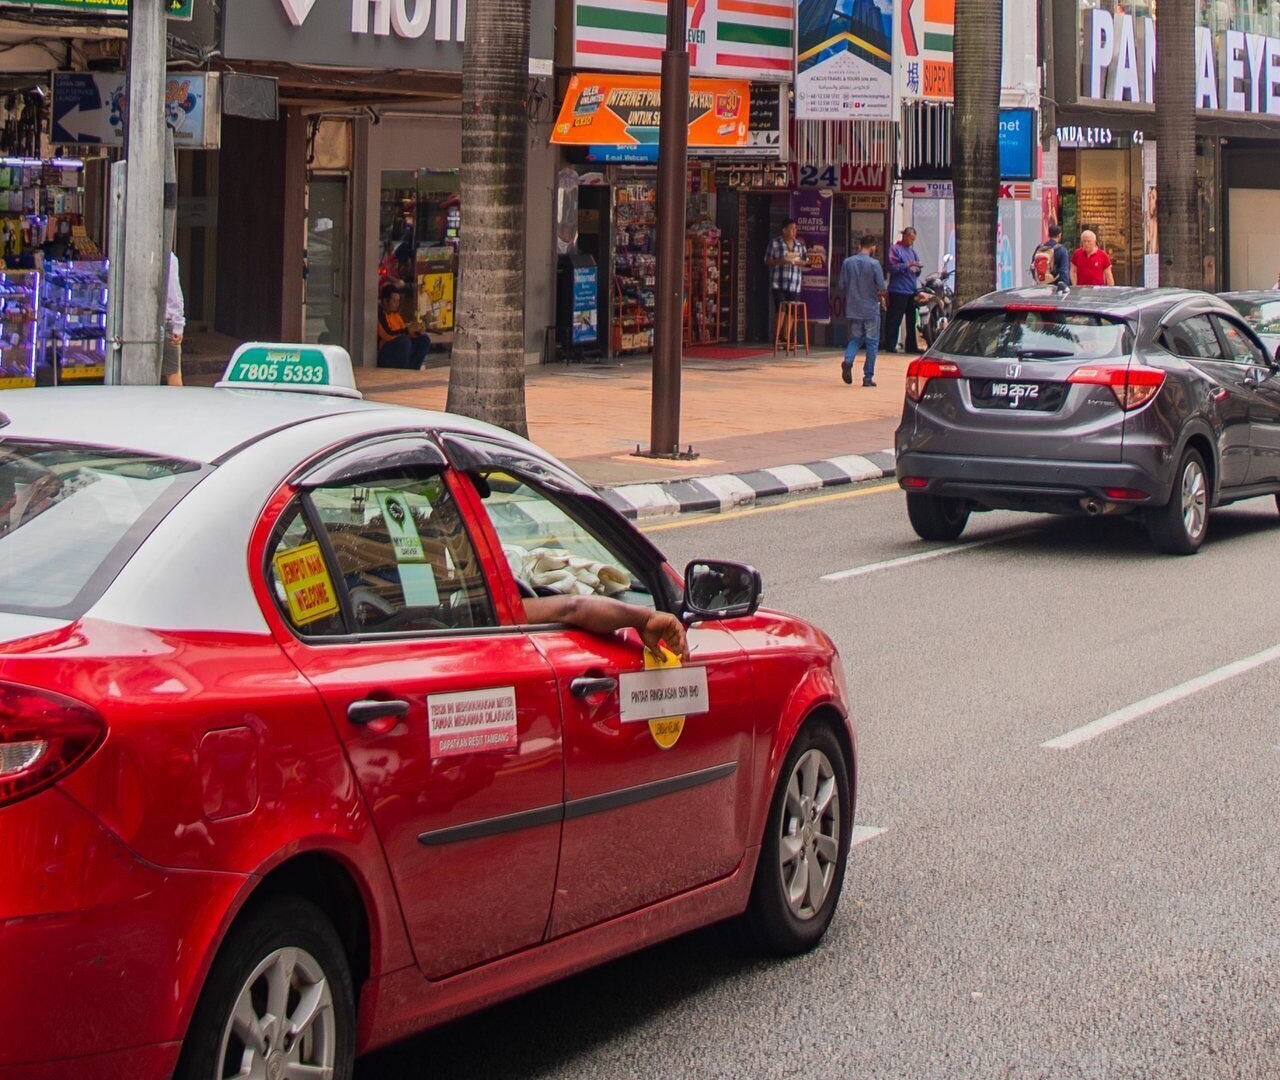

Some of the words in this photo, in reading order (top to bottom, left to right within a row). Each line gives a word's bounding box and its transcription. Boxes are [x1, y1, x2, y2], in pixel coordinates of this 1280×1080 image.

[924, 64, 946, 93] SUPER
[607, 88, 647, 107] INTERNET
[628, 111, 651, 126] UNTUK
[800, 164, 838, 187] 24
[843, 165, 882, 187] JAM
[240, 363, 278, 380] 7805
[283, 365, 323, 382] 5333
[992, 383, 1007, 397] WB
[294, 582, 329, 612] WELCOME
[631, 691, 648, 703] PINTAR
[649, 688, 677, 702] RINGKASAN
[689, 685, 699, 697] BHD
[439, 738, 468, 752] DAPATKAN
[485, 733, 510, 747] TAMBANG
